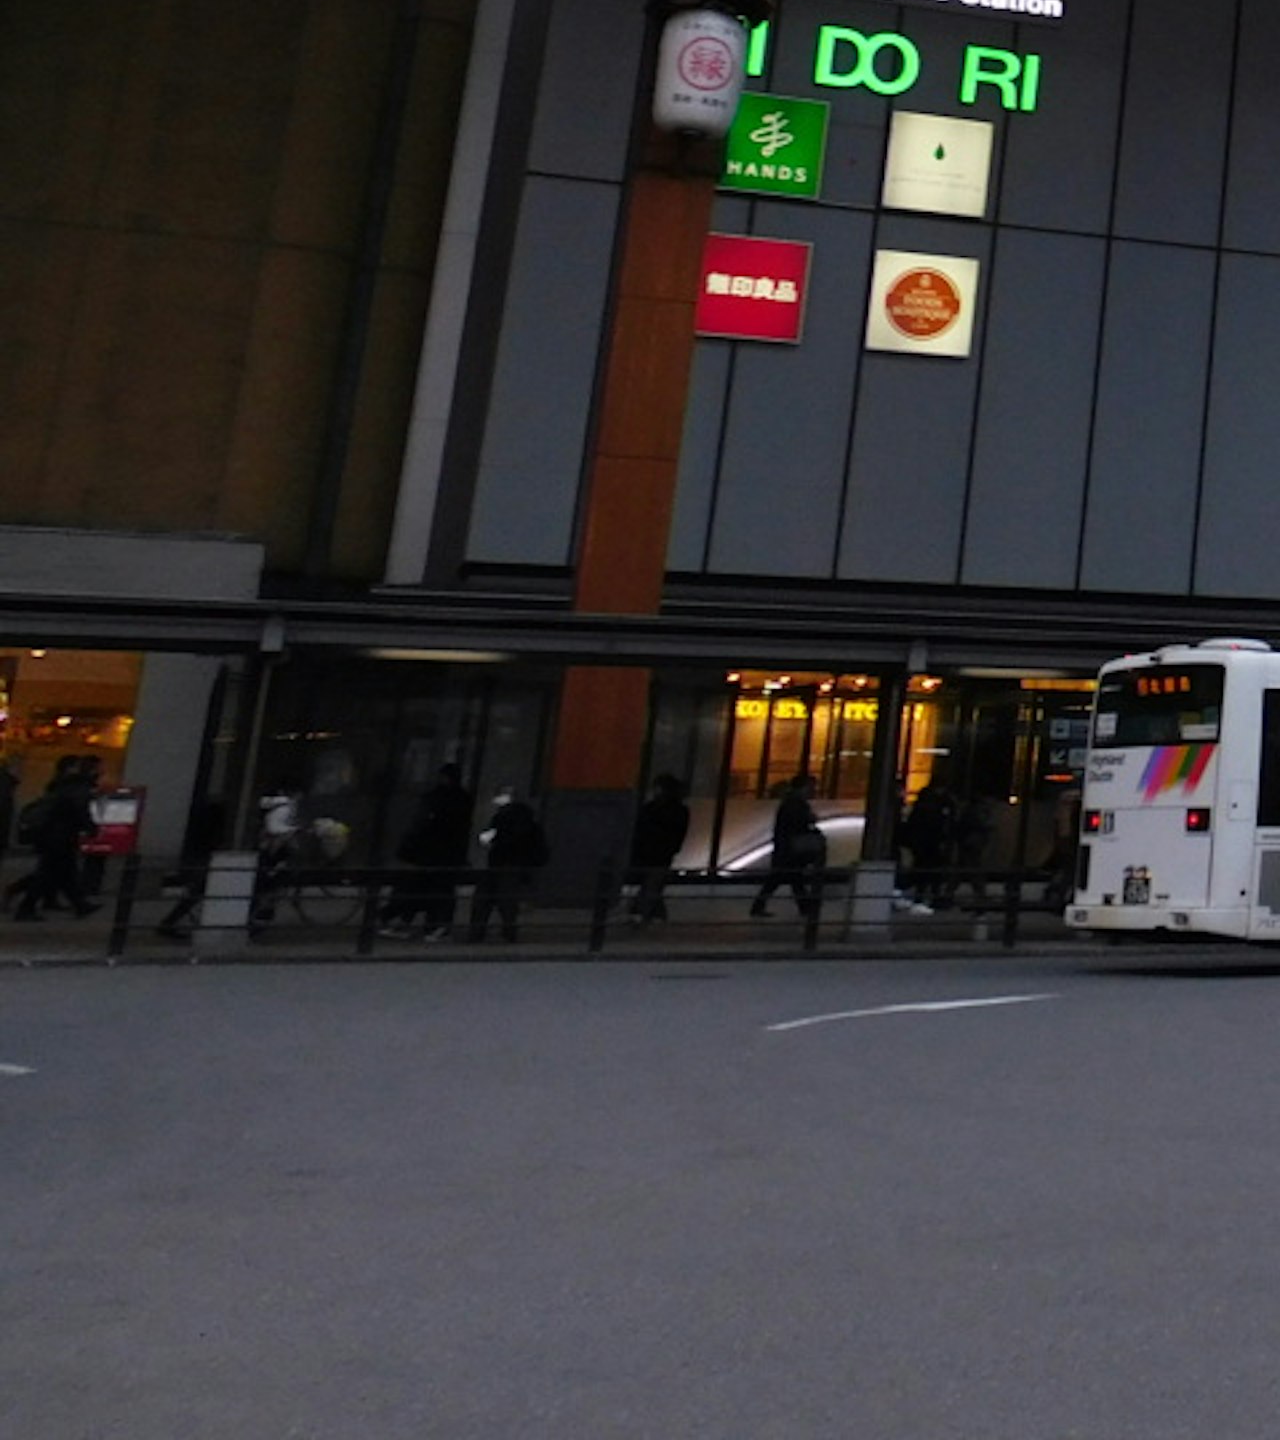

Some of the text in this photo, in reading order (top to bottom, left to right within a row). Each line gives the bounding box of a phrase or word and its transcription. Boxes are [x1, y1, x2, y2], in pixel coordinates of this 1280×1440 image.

[814, 25, 919, 94] DO
[959, 45, 1040, 112] RI
[727, 160, 808, 183] HANDS
[705, 272, 798, 303] 無印良品
